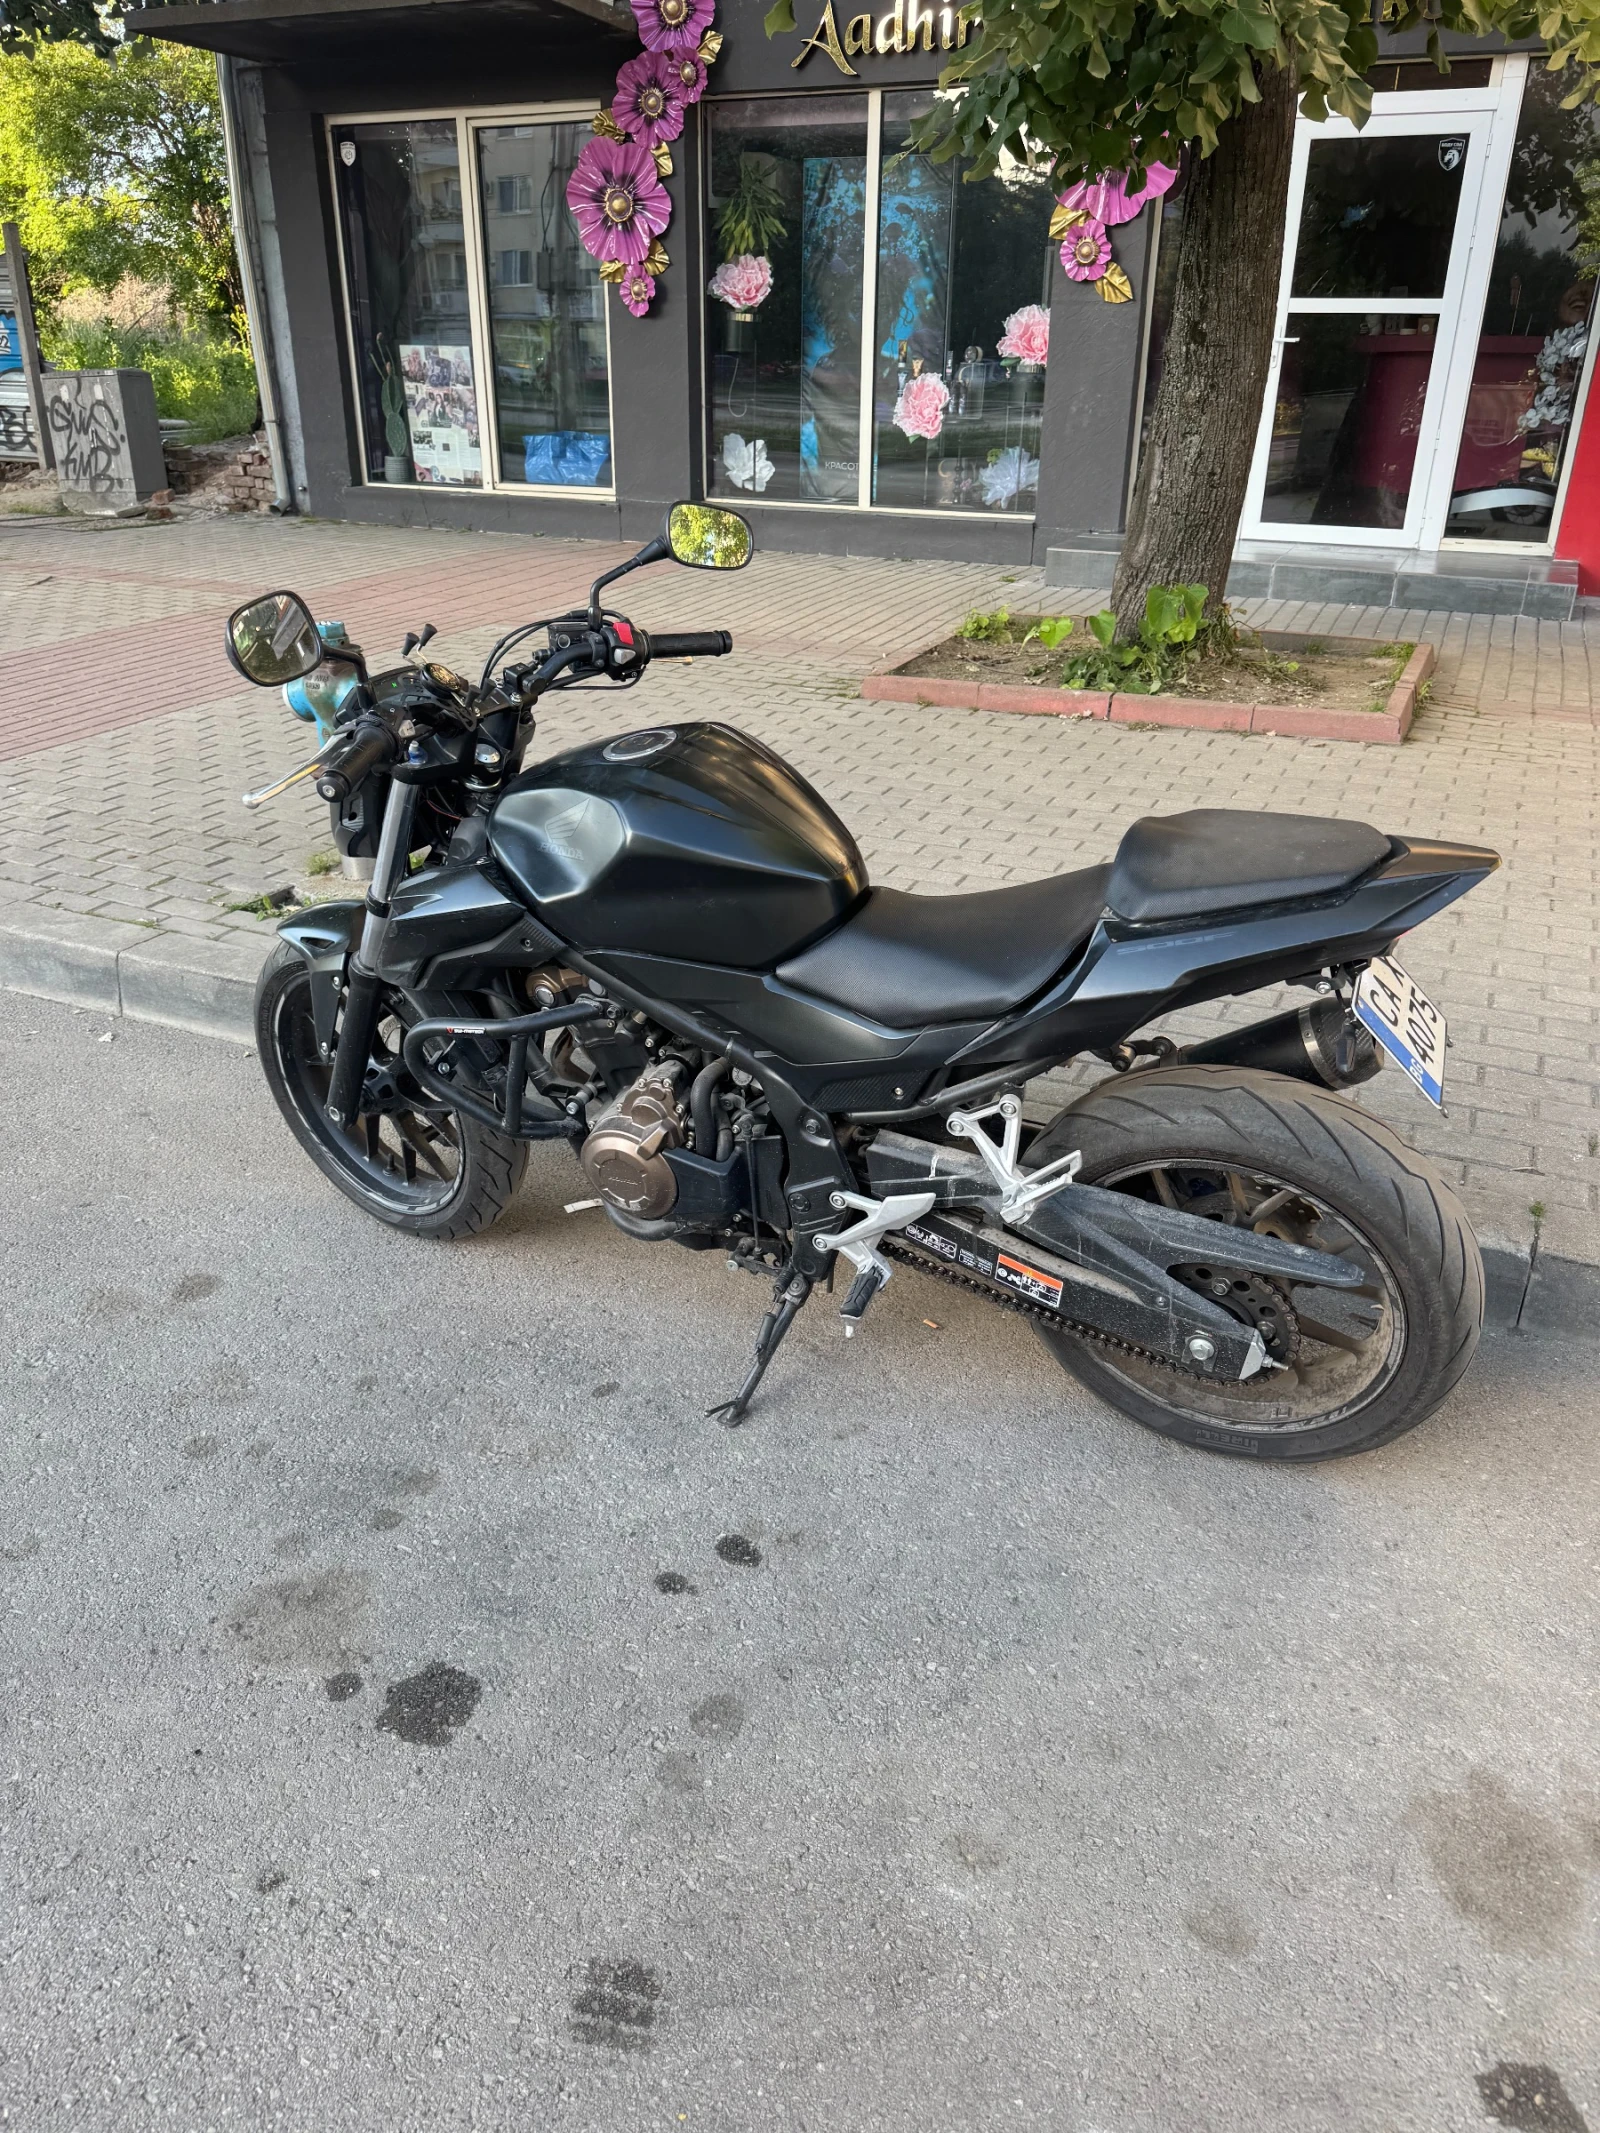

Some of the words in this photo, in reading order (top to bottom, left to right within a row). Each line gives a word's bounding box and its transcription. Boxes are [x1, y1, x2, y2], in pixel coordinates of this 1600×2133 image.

[538, 842, 584, 861] HONDA
[1369, 974, 1402, 1027] CA
[1406, 985, 1437, 1064] 4075
[1409, 1058, 1424, 1085] BG
